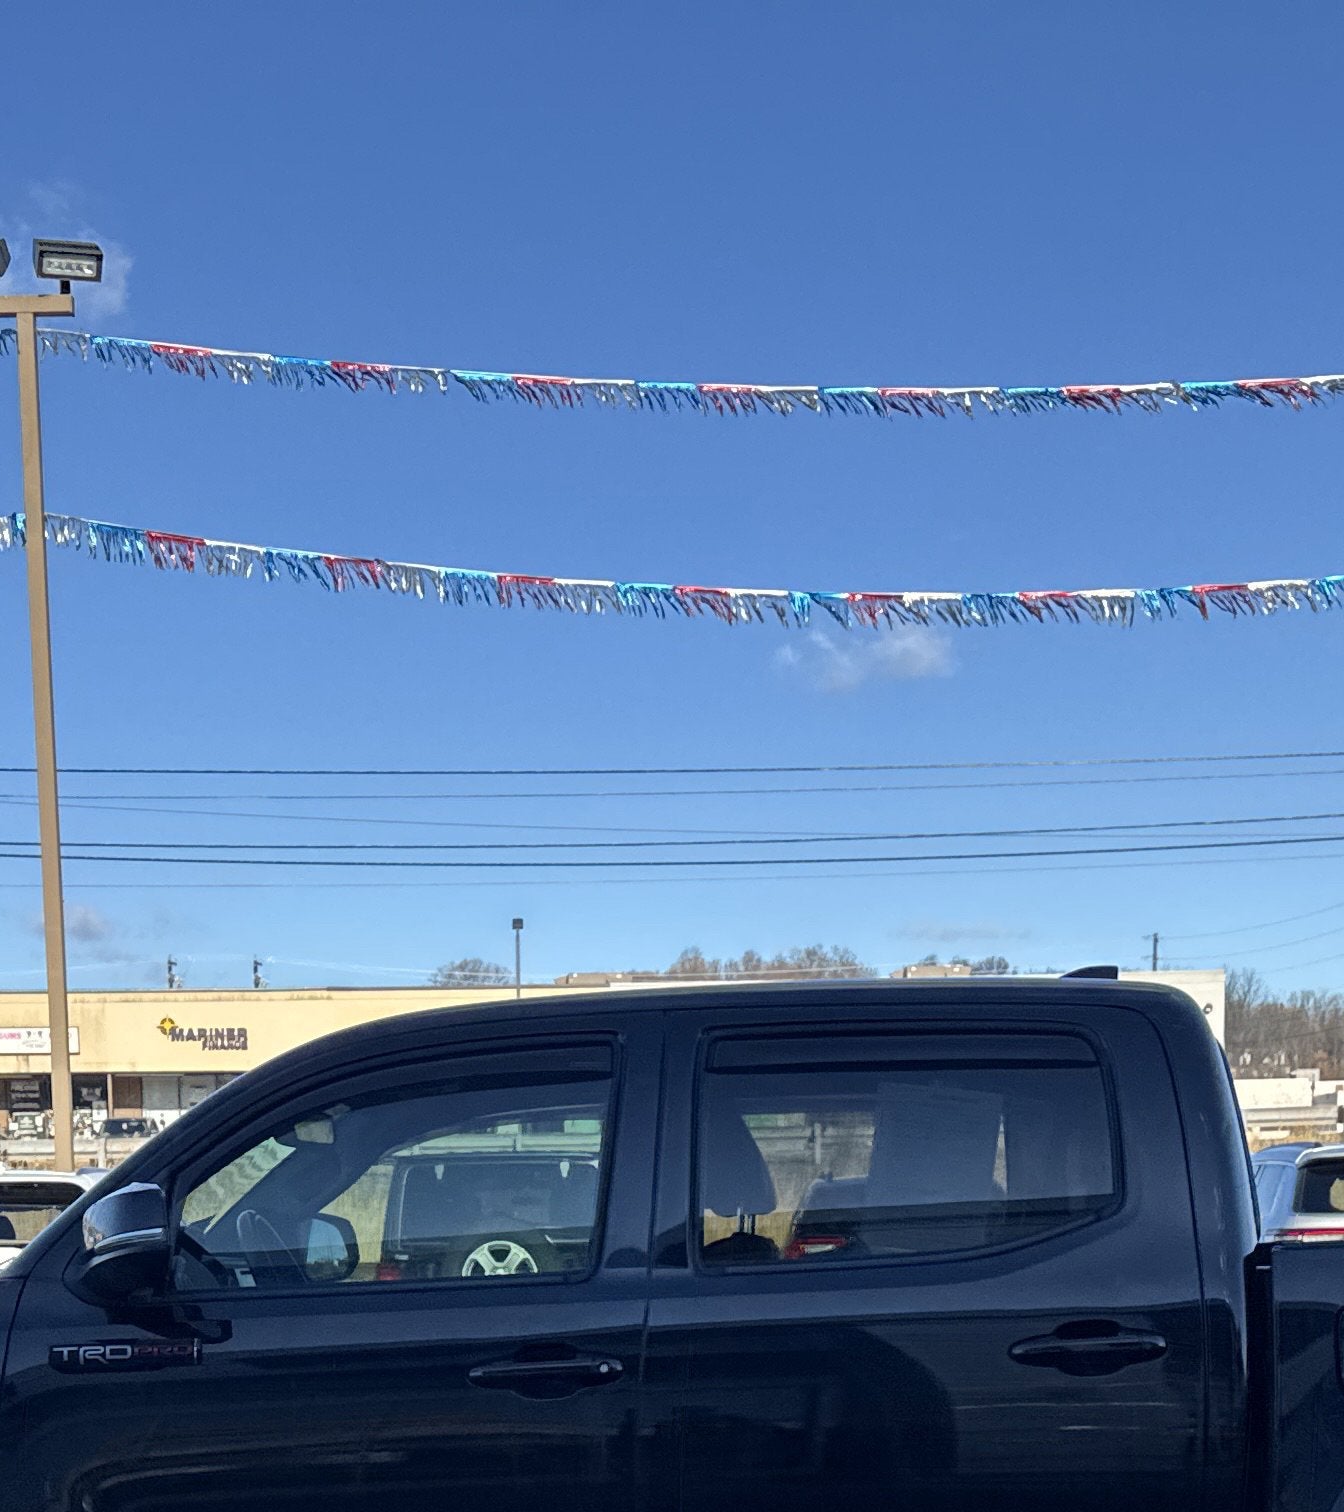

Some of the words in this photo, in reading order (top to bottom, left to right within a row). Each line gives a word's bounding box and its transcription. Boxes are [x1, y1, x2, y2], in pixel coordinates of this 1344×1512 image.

[170, 1027, 248, 1042] MARINER
[202, 1041, 248, 1051] FINANCE
[52, 1344, 133, 1365] TRD
